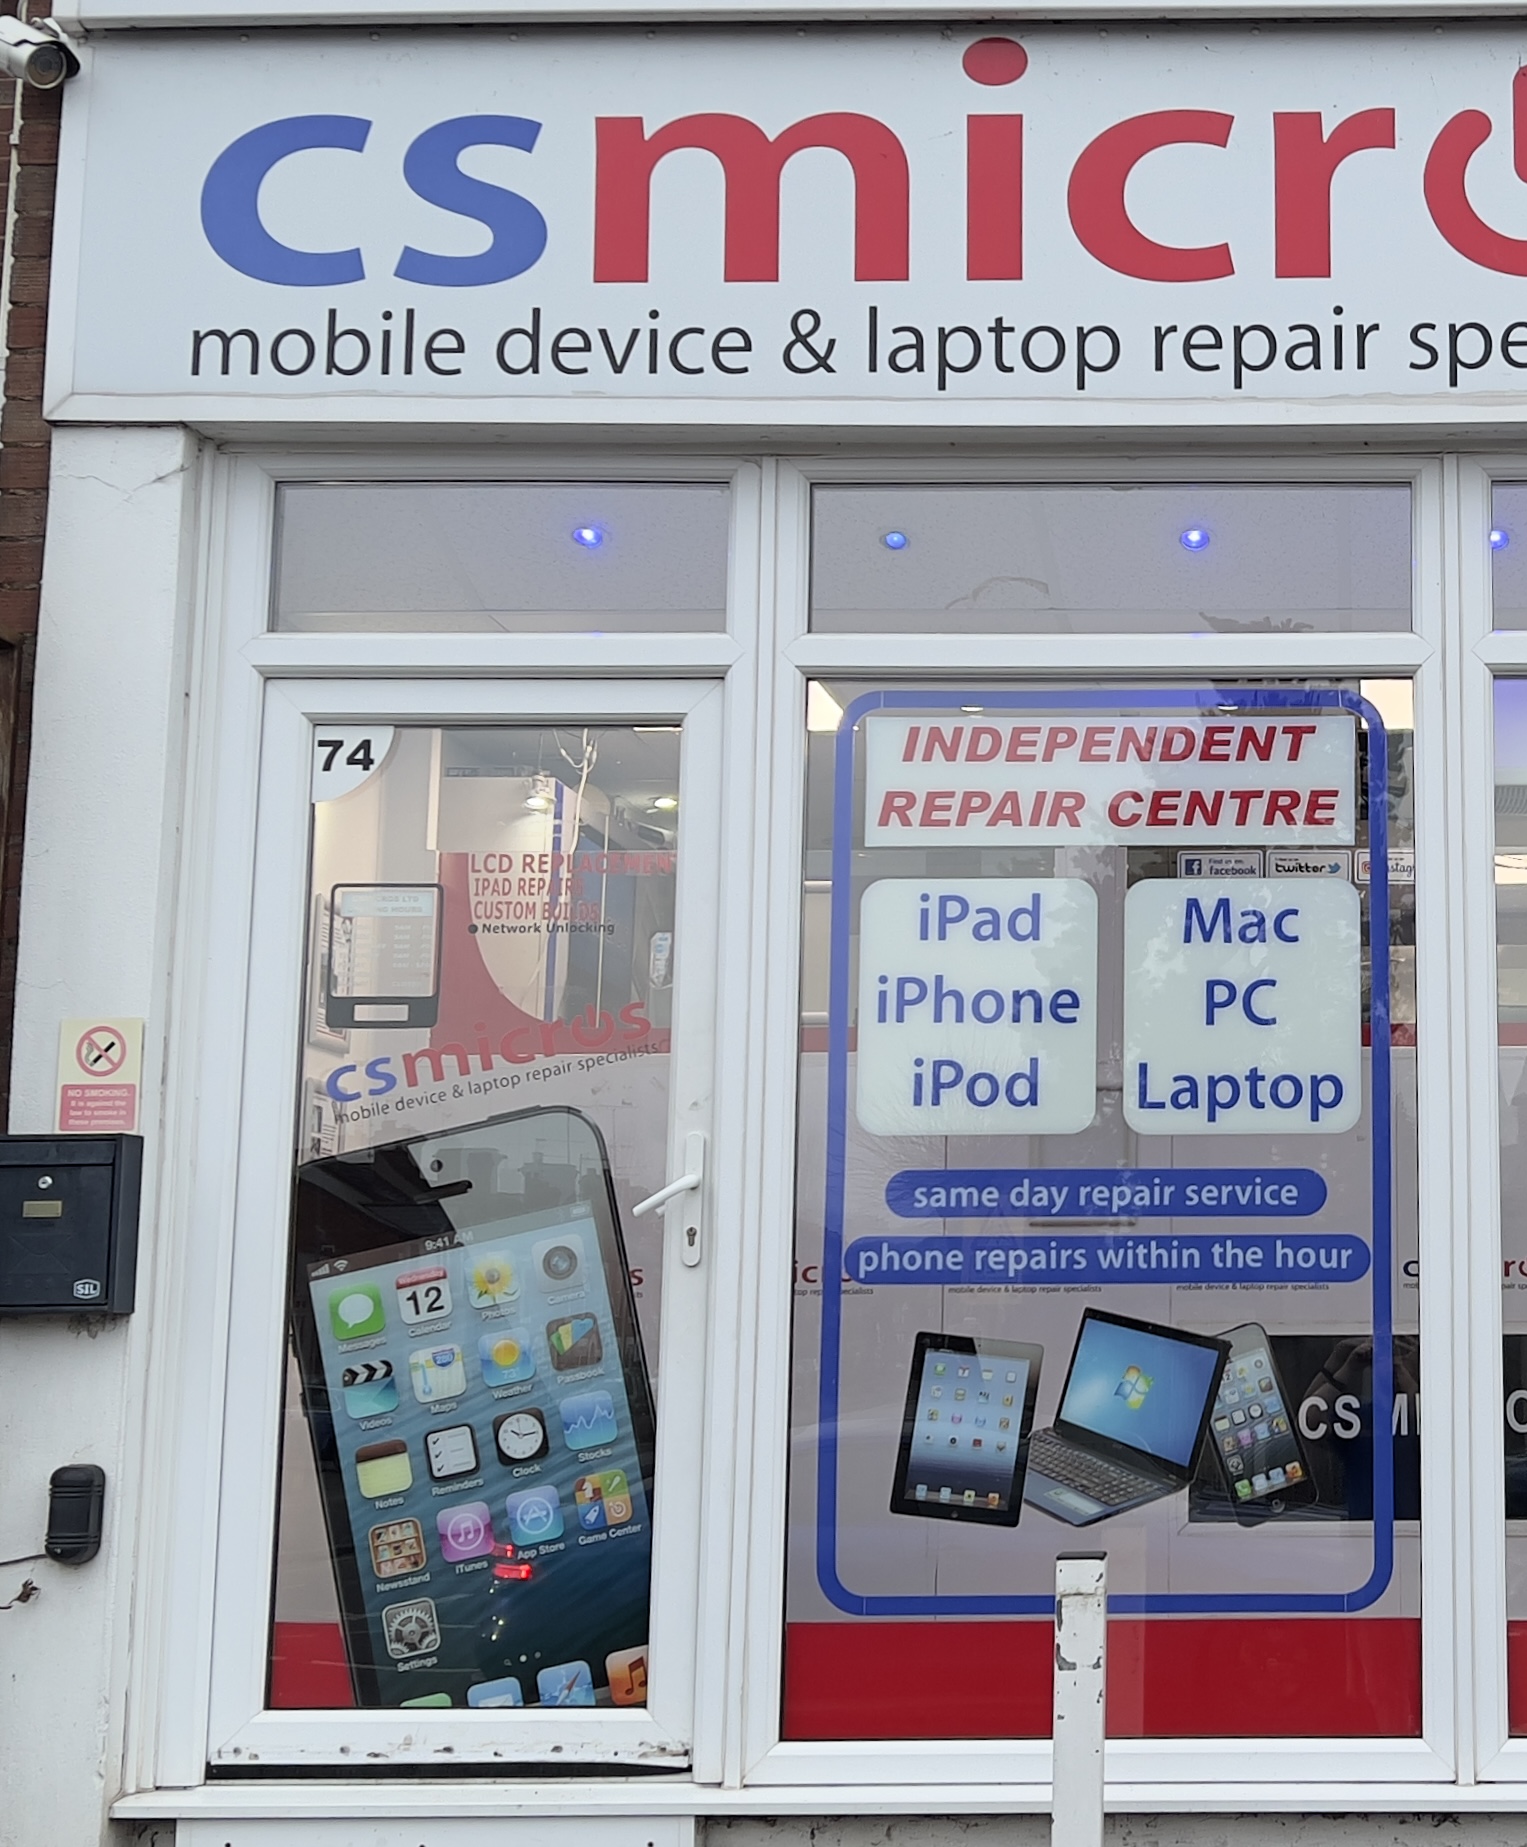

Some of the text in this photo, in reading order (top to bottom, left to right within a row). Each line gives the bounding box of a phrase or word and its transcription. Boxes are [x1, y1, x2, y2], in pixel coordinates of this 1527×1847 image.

[190, 307, 466, 378] mobile
[495, 307, 753, 376] device
[780, 307, 838, 375] &
[868, 305, 1122, 391] laptop
[1153, 305, 1380, 390] repair
[901, 725, 1316, 763] INDEPENDENT
[317, 739, 375, 772] 74
[877, 788, 1340, 828] REPAIR CENTRE
[470, 853, 513, 874] LCD
[1209, 865, 1257, 876] facebook
[1275, 862, 1326, 873] twitter
[474, 877, 511, 897] IPAD
[474, 901, 536, 920] CUSTOM
[918, 892, 1042, 942] iPad
[1182, 897, 1300, 944] Mac
[482, 922, 615, 936] Network Unlocking
[876, 975, 1081, 1024] iPhone
[1204, 979, 1278, 1027] PC
[325, 1001, 652, 1103] csmicros
[336, 1040, 659, 1124] mobile device & laptop repair specialists
[912, 1057, 1039, 1107] iPod
[1137, 1062, 1344, 1123] Laptop
[67, 1089, 82, 1097] NO
[913, 1178, 1299, 1214] same day repair service
[425, 1231, 474, 1251] 9:41 AM
[857, 1238, 1353, 1279] phone repairs within the hour
[76, 1283, 97, 1295] SIL
[406, 1286, 445, 1316] 12
[557, 1369, 605, 1385] Passbook
[492, 1384, 532, 1399] Weather
[430, 1402, 458, 1415] Maps
[1298, 1394, 1361, 1440] CS
[359, 1417, 392, 1431] Videos
[577, 1448, 612, 1462] Stocks
[512, 1465, 542, 1478] Clock
[431, 1479, 484, 1497] Reminders
[375, 1497, 404, 1510] Notes
[578, 1524, 642, 1546] Game Center
[517, 1543, 566, 1560] App Store
[376, 1572, 431, 1593] Newsstand
[397, 1656, 438, 1672] Settings
